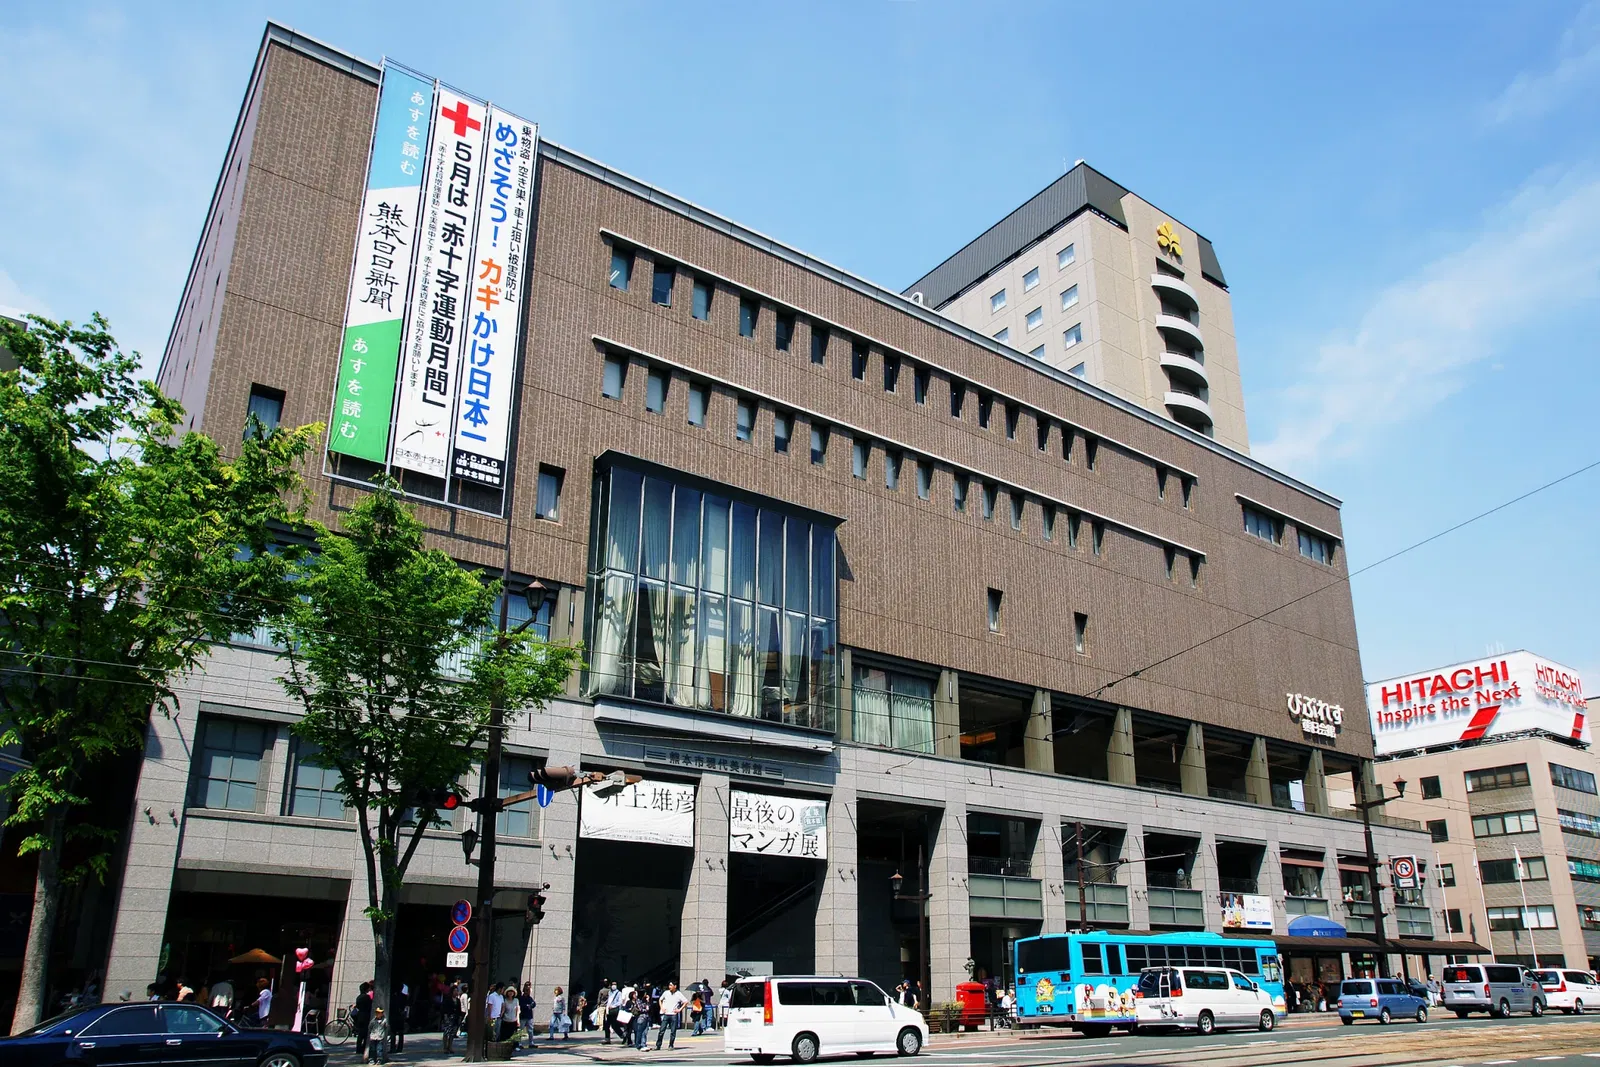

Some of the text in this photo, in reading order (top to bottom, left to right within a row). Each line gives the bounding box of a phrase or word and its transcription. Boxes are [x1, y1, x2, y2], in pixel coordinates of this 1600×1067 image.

[400, 91, 425, 176] あすを読む
[359, 201, 409, 313] 熊本日日新聞
[340, 337, 369, 439] あすを読む
[1381, 660, 1510, 707] HITACHI
[1534, 662, 1583, 695] HITACHI
[1377, 681, 1522, 725] Inspire the Next
[669, 751, 763, 776] 熊本市現代美術館
[731, 798, 795, 825] 最後の
[731, 831, 819, 857] マンガ展
